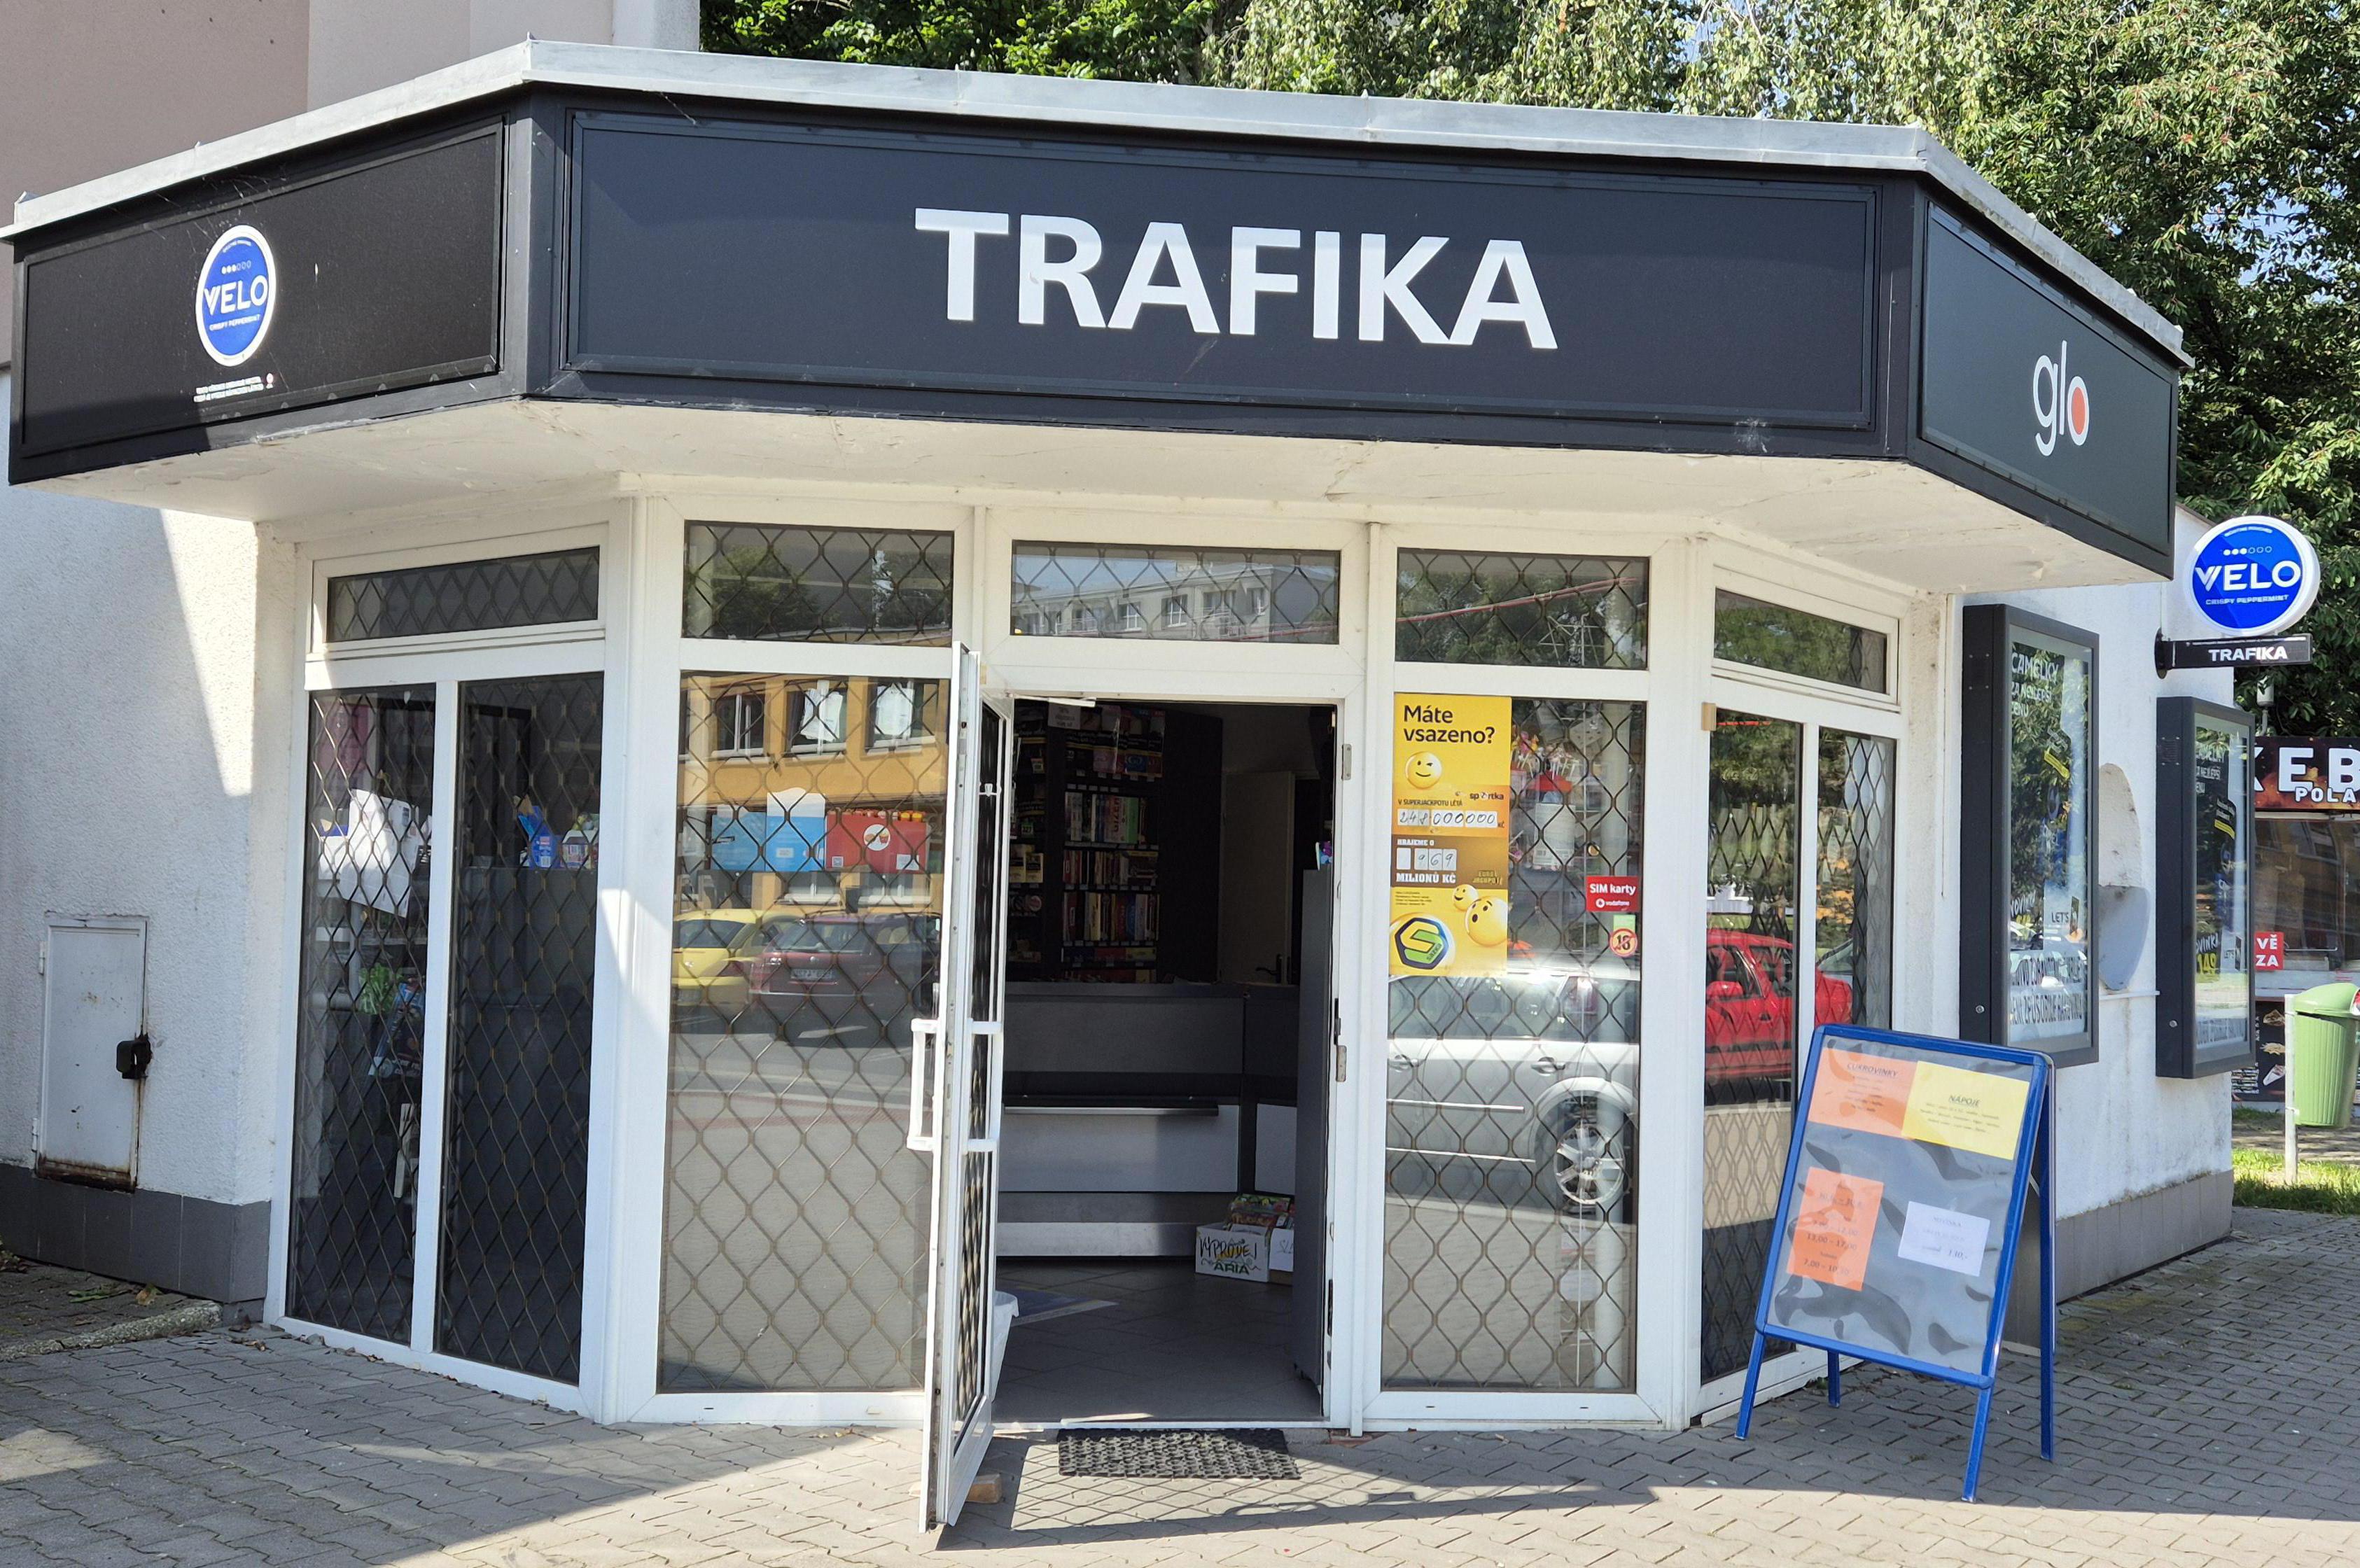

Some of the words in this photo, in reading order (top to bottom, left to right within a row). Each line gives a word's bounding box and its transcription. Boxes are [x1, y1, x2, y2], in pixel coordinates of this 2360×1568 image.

[915, 208, 1558, 350] TRAFIKA
[204, 275, 268, 316] VELO
[2033, 340, 2089, 456] glo
[2195, 561, 2301, 592] VELO
[2208, 646, 2288, 662] TRAFIKA
[1404, 705, 1453, 723] Máte
[1404, 727, 1495, 743] vsazeno?
[1396, 871, 1439, 883] MILIONŮ
[1590, 883, 1608, 893] SIM
[1610, 884, 1636, 895] karty
[1847, 1063, 1898, 1077] CUKROVINKY
[1214, 1261, 1250, 1275] ARIA
